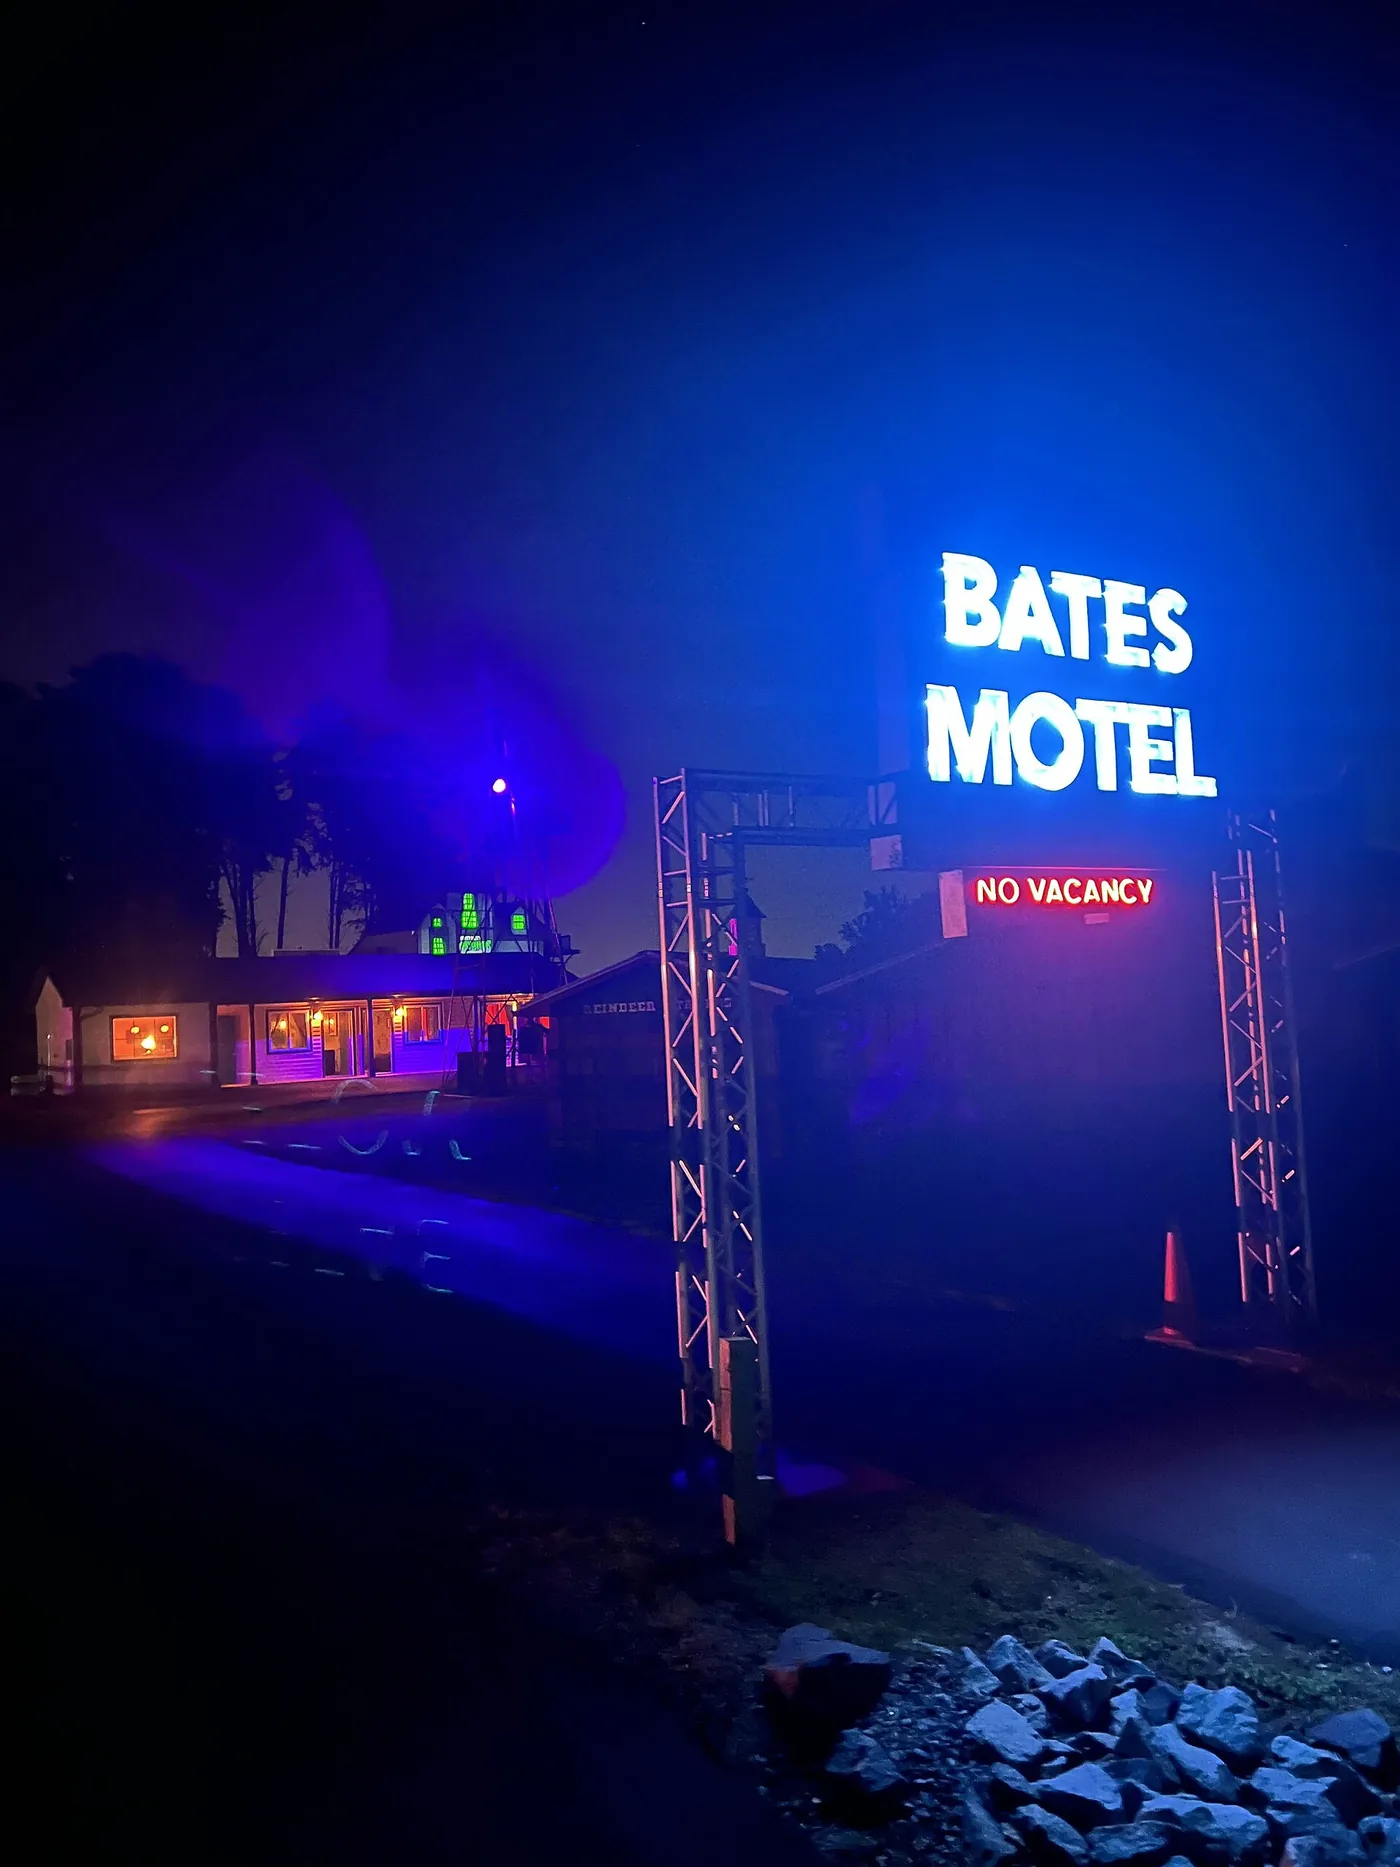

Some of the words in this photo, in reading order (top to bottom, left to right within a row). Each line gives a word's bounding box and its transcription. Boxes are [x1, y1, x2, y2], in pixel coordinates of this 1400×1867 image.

[940, 552, 1193, 675] BATES
[924, 684, 1218, 798] MOTEL
[975, 877, 1020, 905] NO
[1027, 877, 1155, 906] VACANCY
